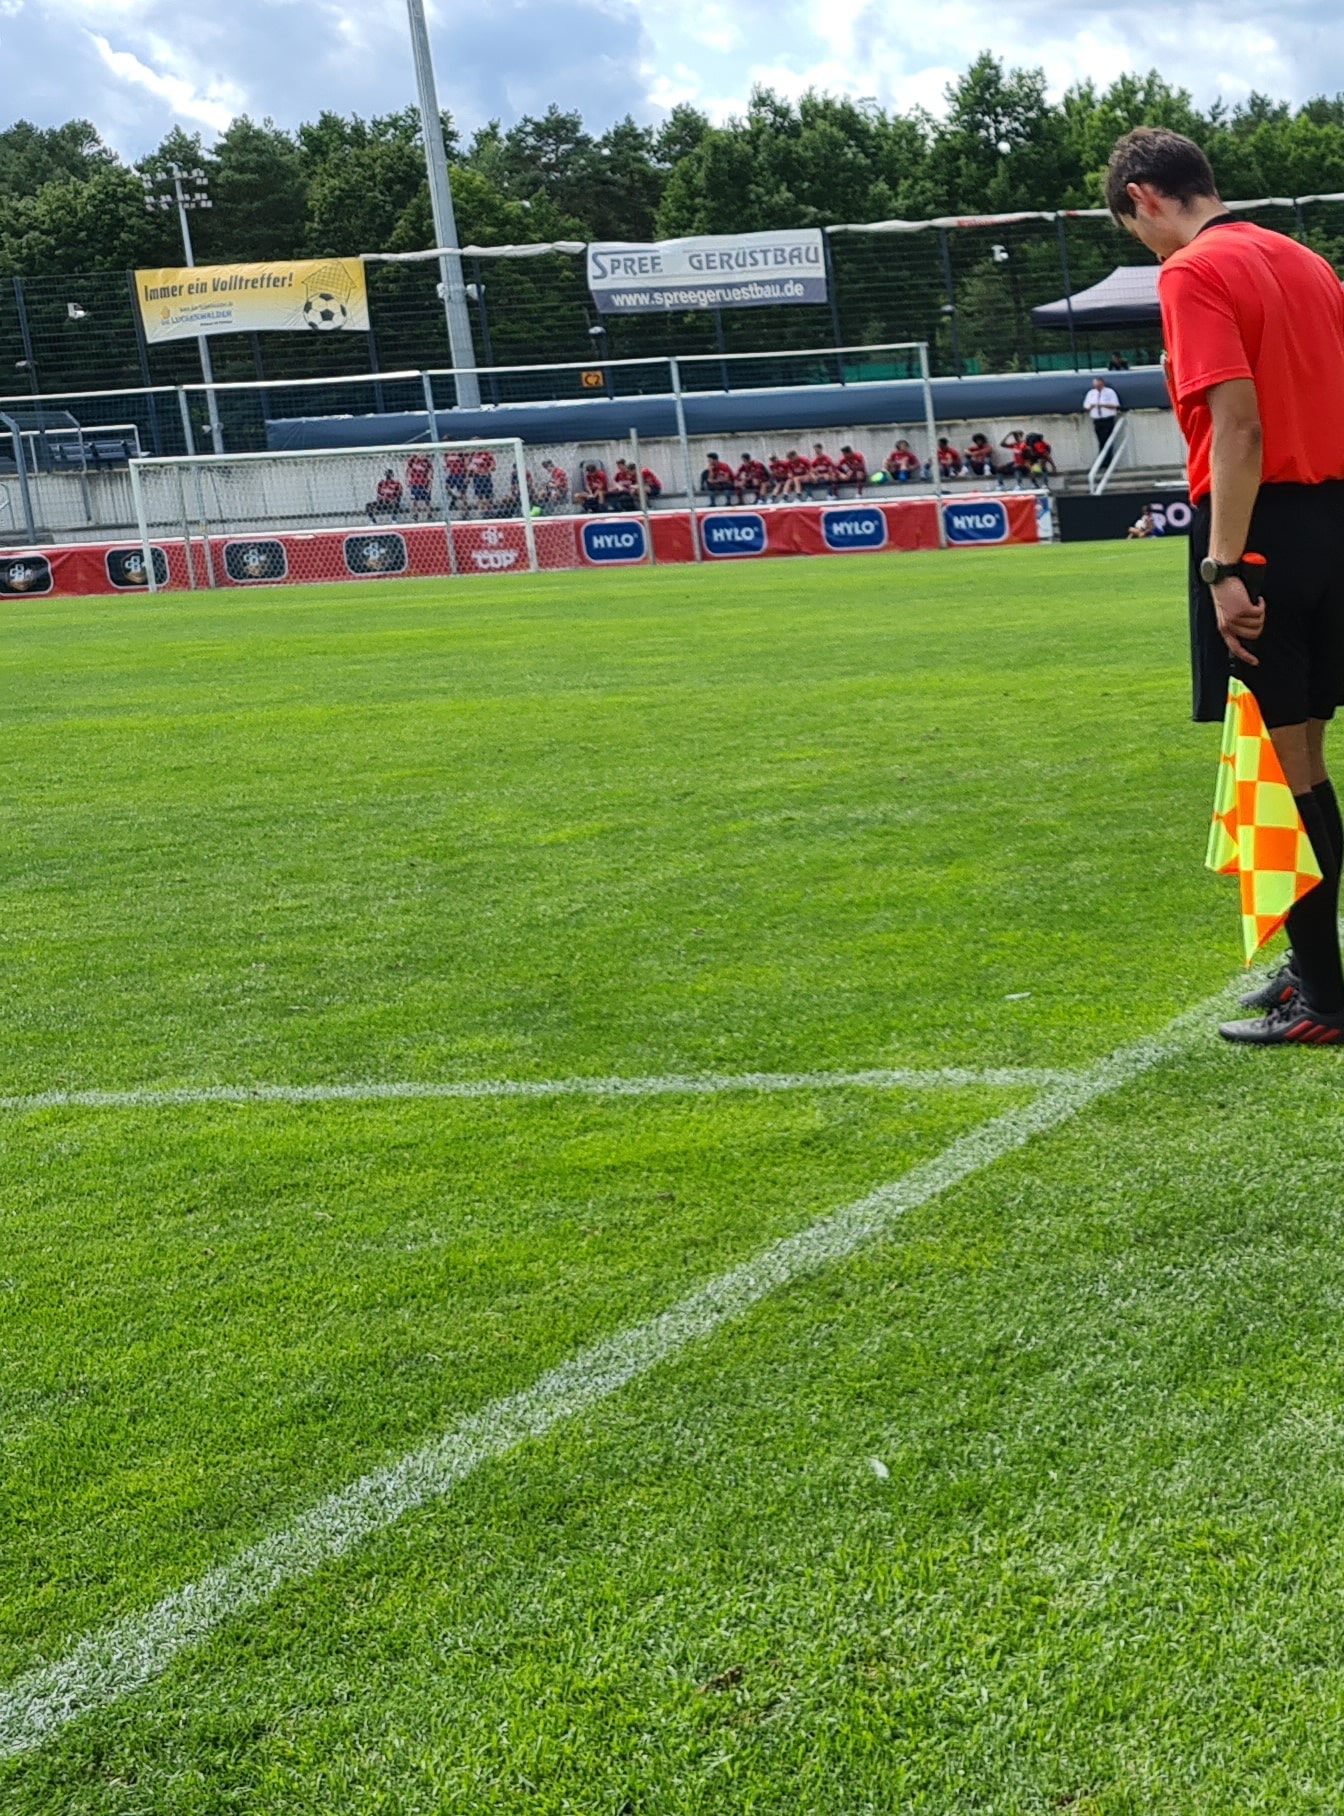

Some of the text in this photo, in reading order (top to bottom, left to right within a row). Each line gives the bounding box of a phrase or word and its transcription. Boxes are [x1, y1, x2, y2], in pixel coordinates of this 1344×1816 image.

[592, 246, 820, 279] SPREE GERÜSTBAU
[144, 273, 293, 301] Immer ein Volltreffer!
[611, 280, 805, 308] www.spreegeruestbau.de
[833, 520, 876, 536] HYLO
[953, 514, 996, 530] HYLO
[592, 533, 635, 549] HYLO
[712, 527, 755, 542] HYLO
